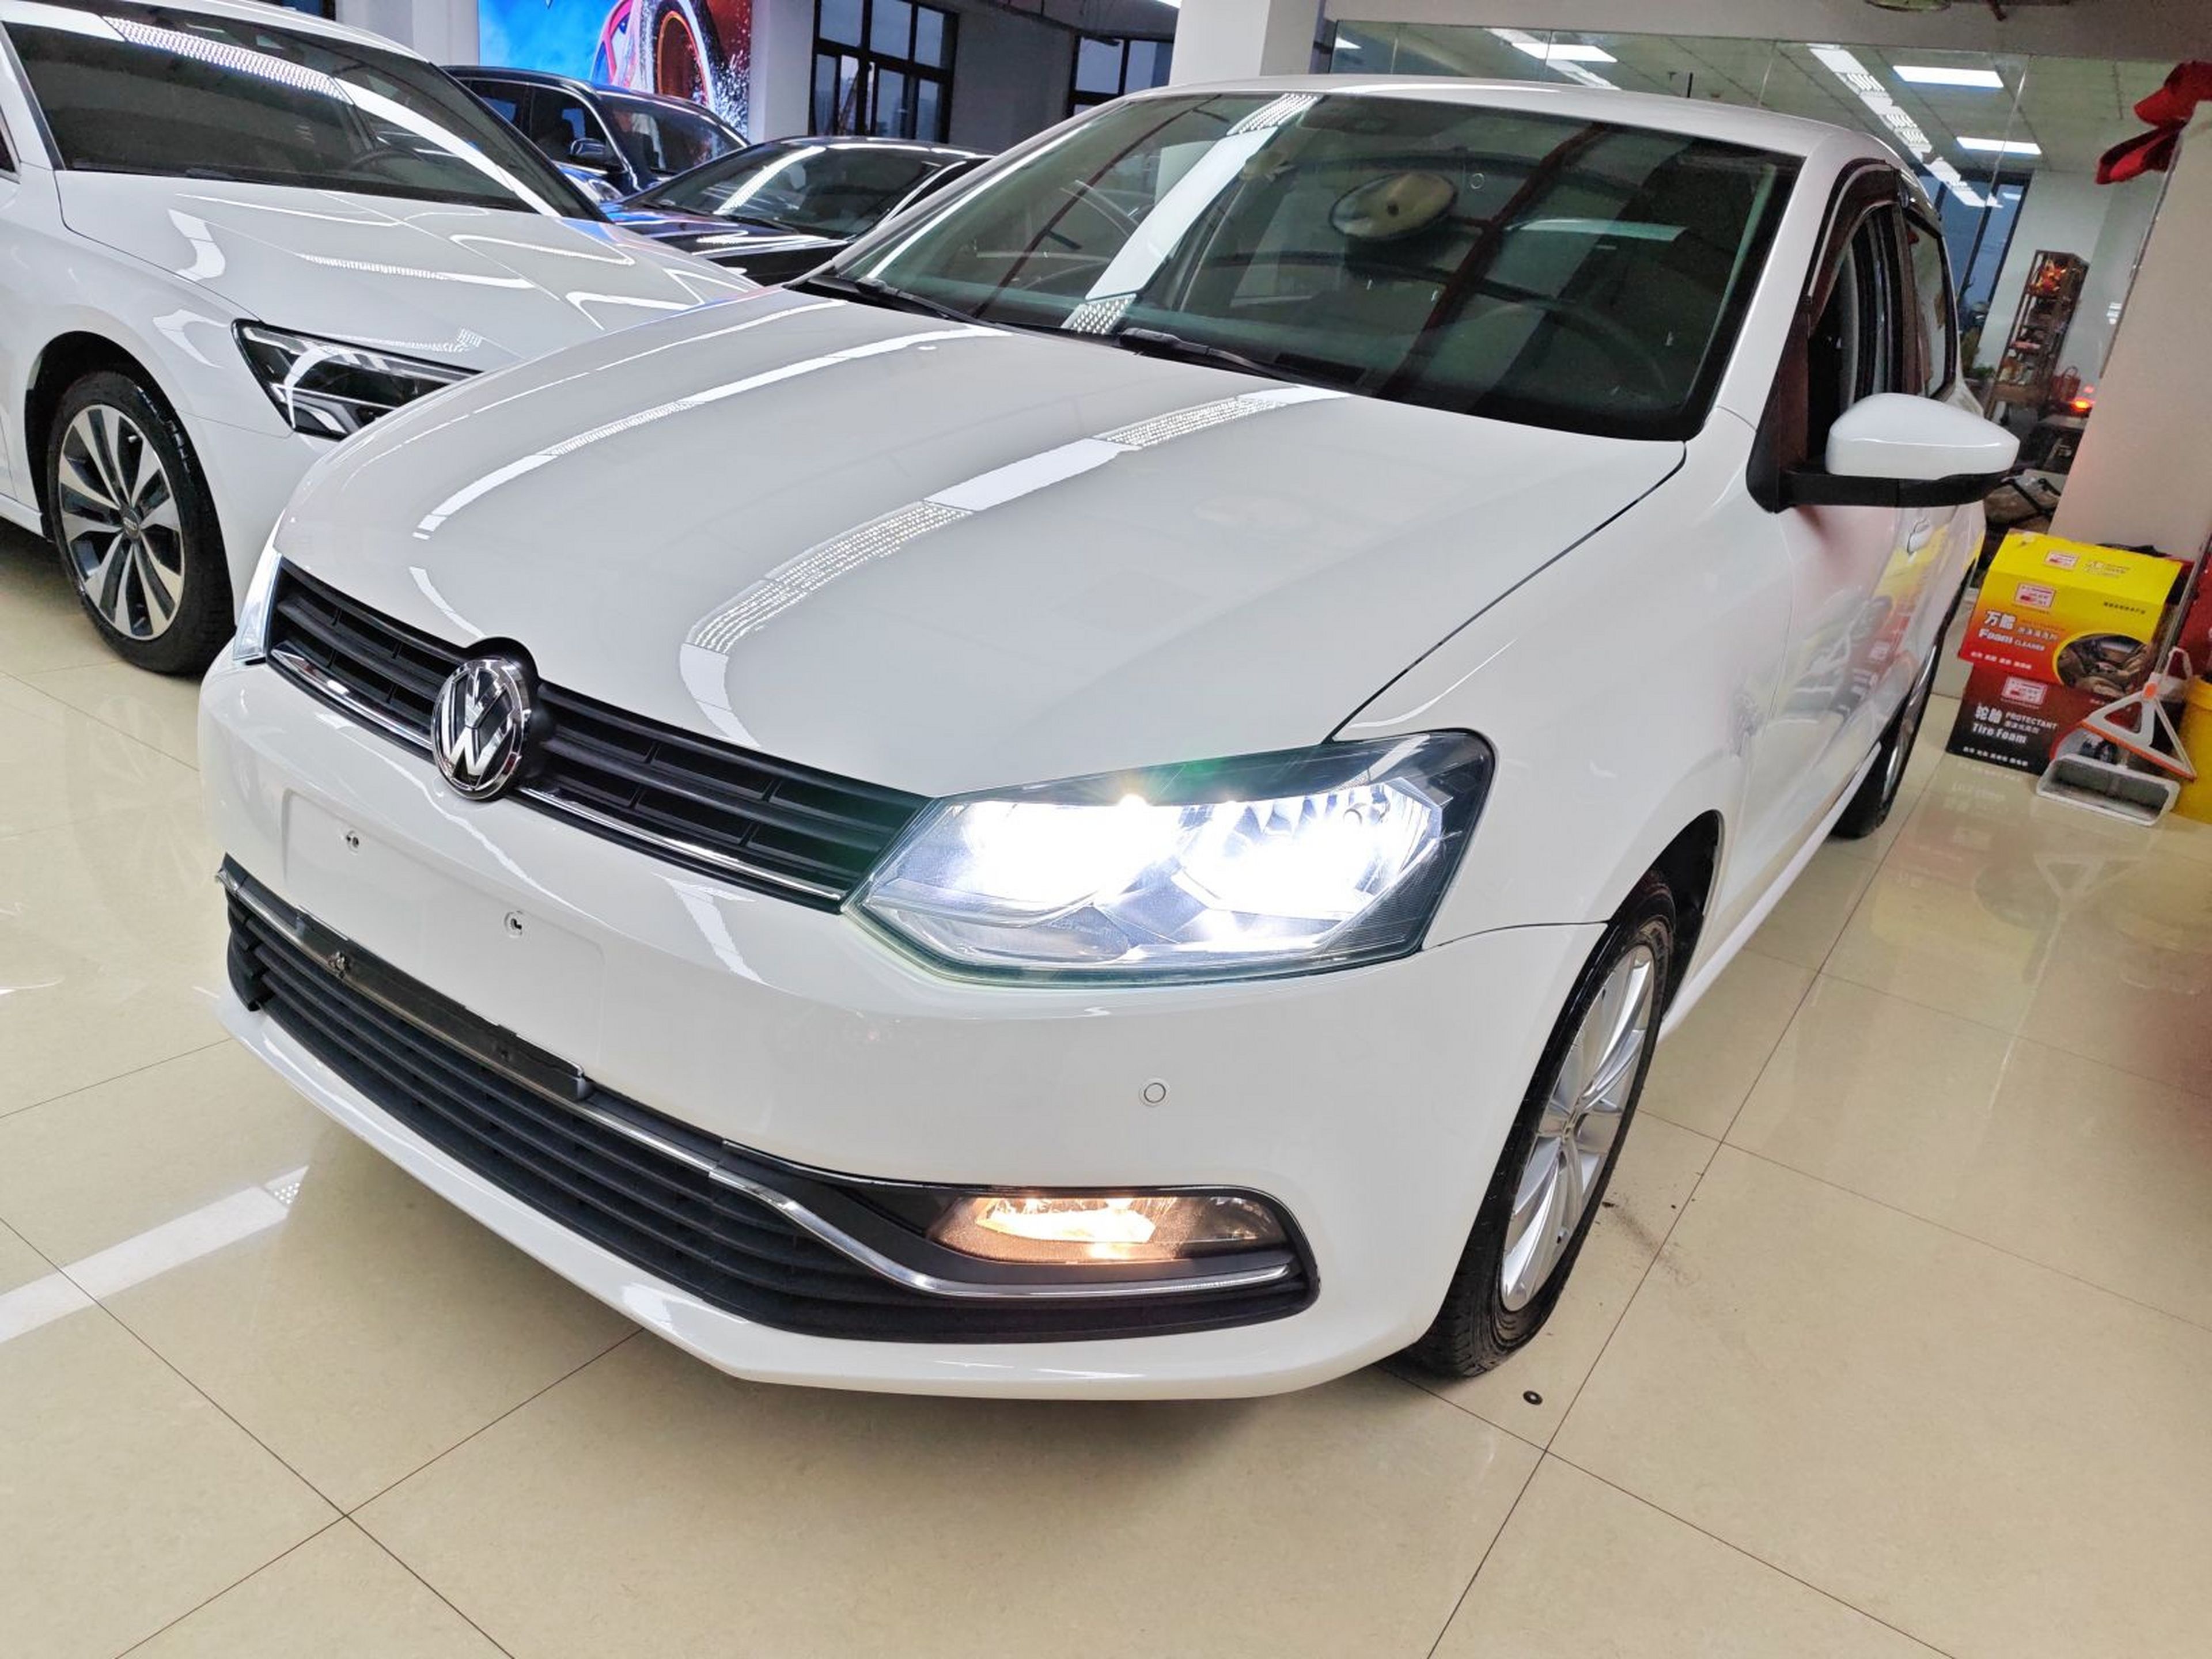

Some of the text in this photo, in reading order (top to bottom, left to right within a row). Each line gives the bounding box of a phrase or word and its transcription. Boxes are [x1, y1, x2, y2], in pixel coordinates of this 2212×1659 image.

[1979, 628, 2013, 644] Foam
[2005, 711, 2058, 729] PROTECTANT
[1972, 722, 1994, 736] Tire
